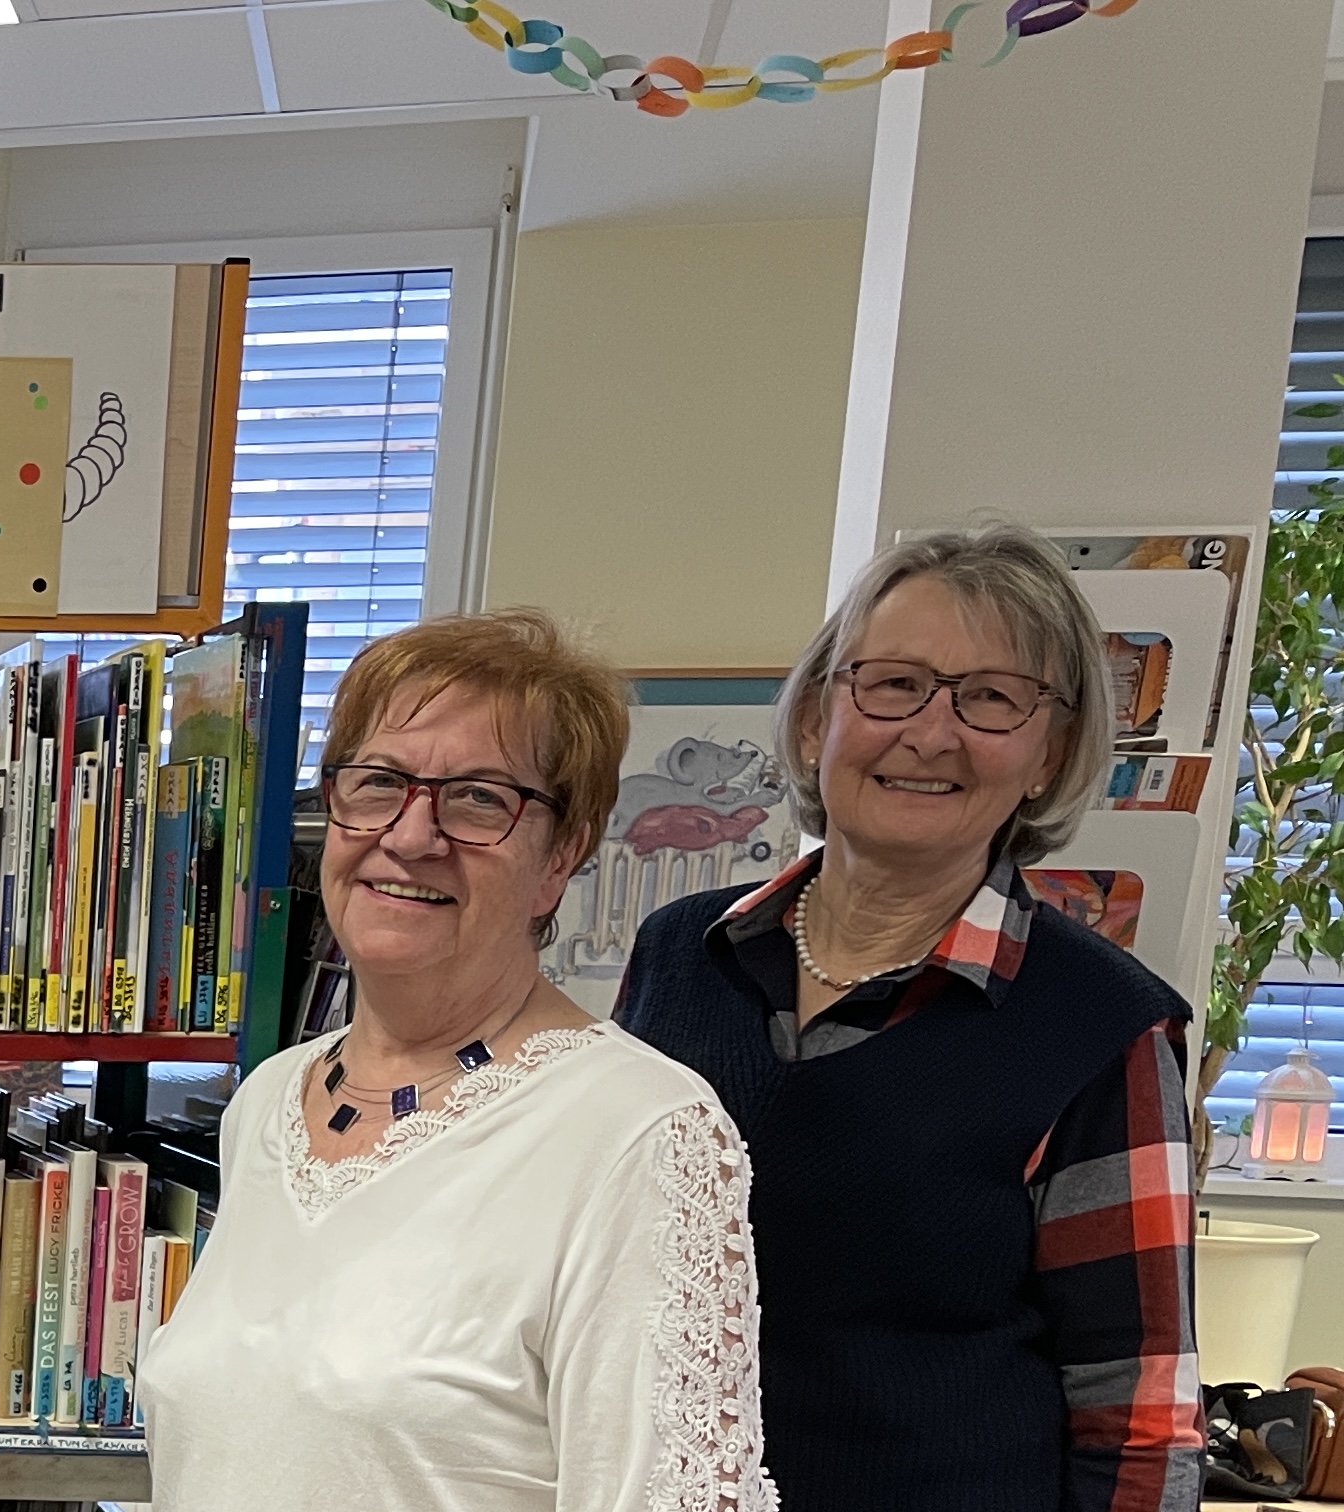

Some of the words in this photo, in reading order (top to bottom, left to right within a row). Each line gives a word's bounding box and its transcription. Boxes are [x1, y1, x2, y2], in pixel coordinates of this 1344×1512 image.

[51, 1181, 63, 1233] FRICKE
[120, 1188, 139, 1252] GROW
[43, 1281, 58, 1322] FEST
[116, 1310, 128, 1346] Lucas
[41, 1331, 56, 1368] DAS
[115, 1349, 127, 1373] Lilly
